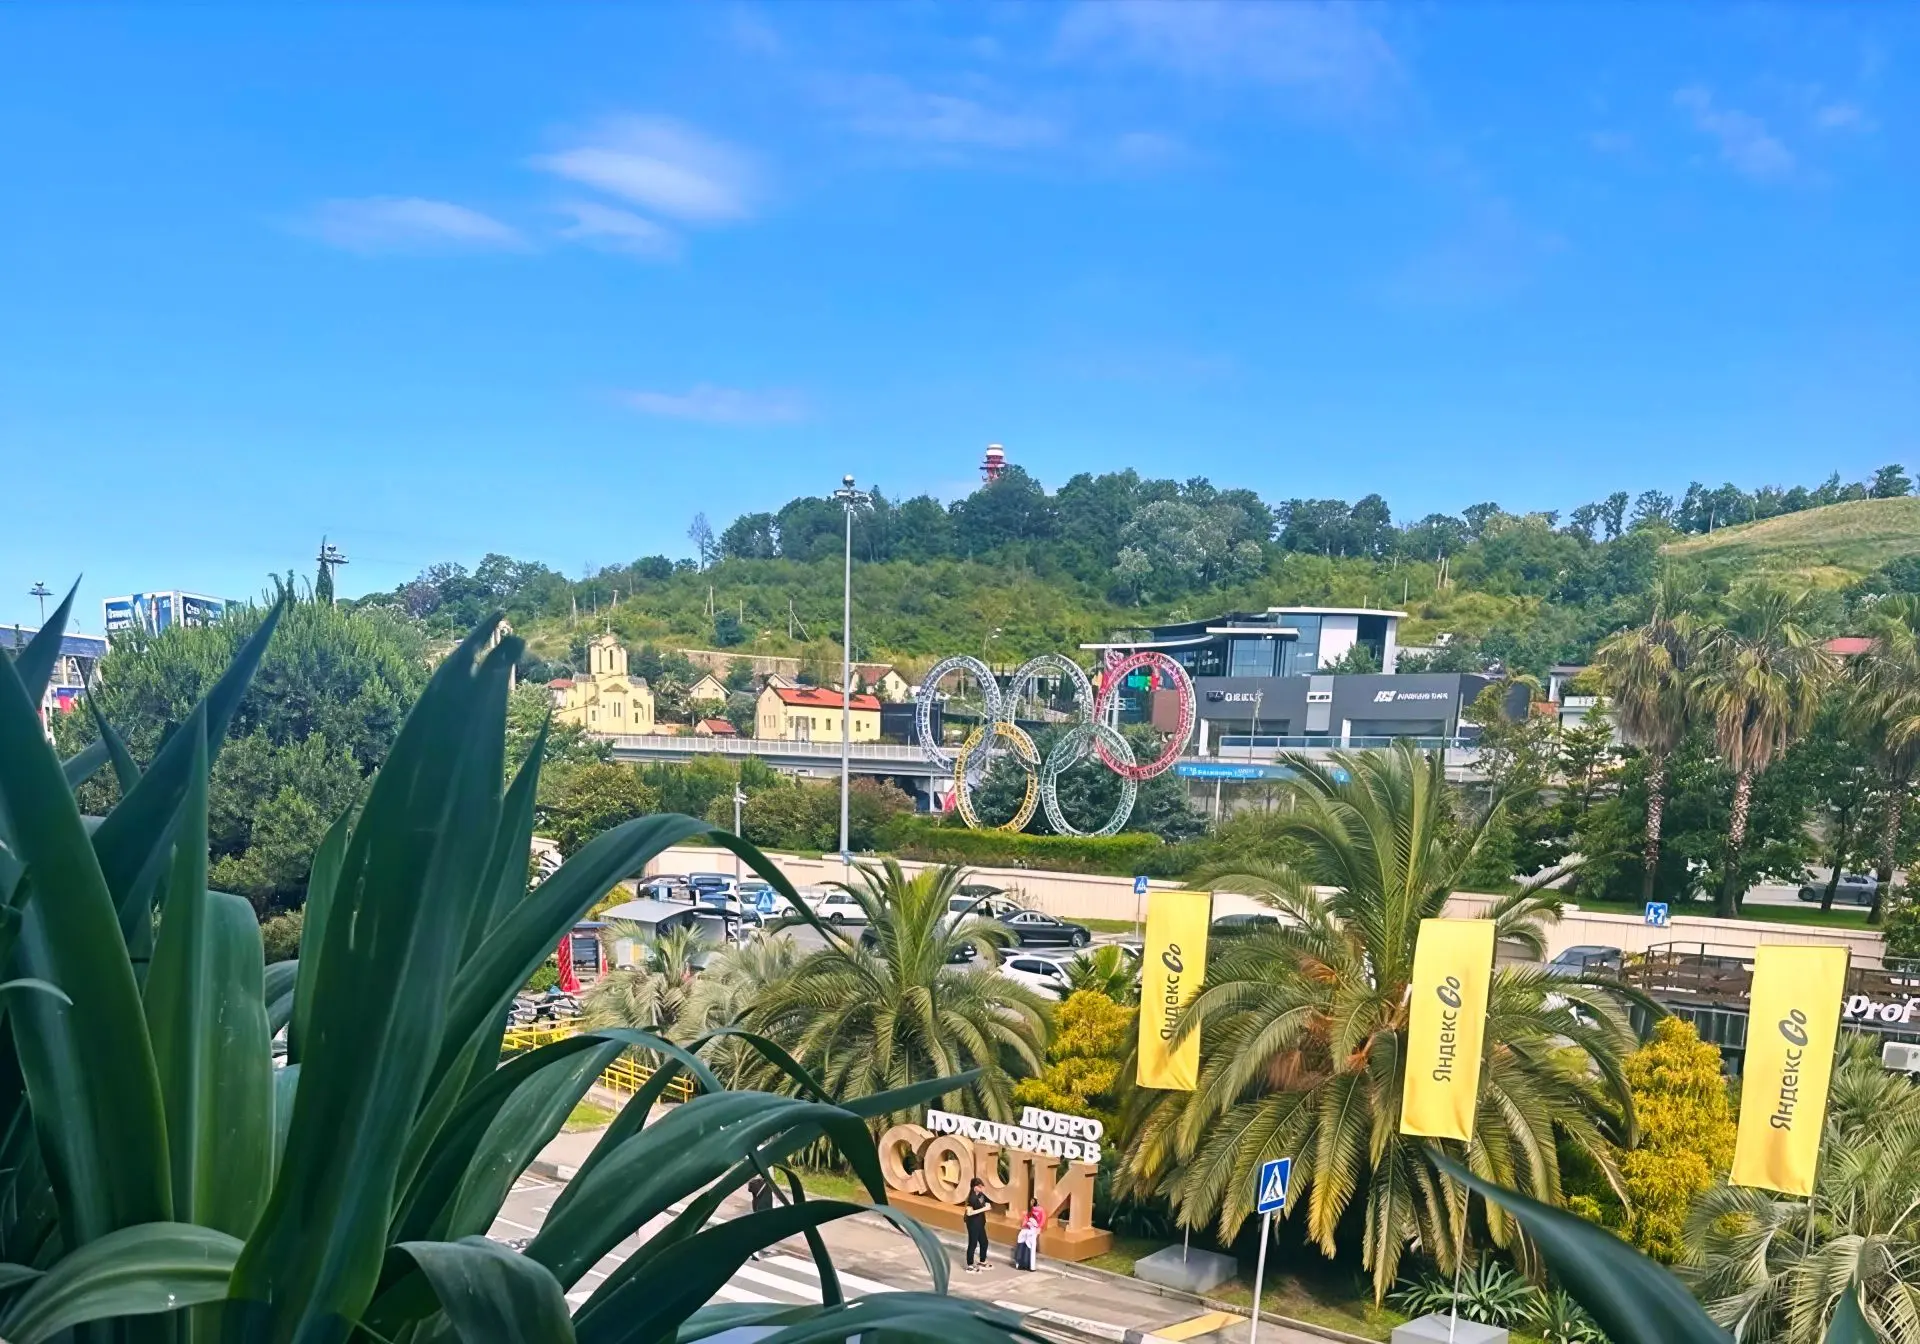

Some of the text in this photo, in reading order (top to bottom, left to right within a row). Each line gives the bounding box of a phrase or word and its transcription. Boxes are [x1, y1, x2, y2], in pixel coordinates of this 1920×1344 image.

[1160, 943, 1184, 1041] Яндекс Go
[1432, 976, 1462, 1082] Яндекс Go
[1770, 1008, 1809, 1132] Яндекс Go
[927, 1109, 1102, 1165] ПОЖАЛОВАТЬ В
[1020, 1106, 1103, 1141] ДОБРО
[878, 1124, 1098, 1241] СОЧИ
